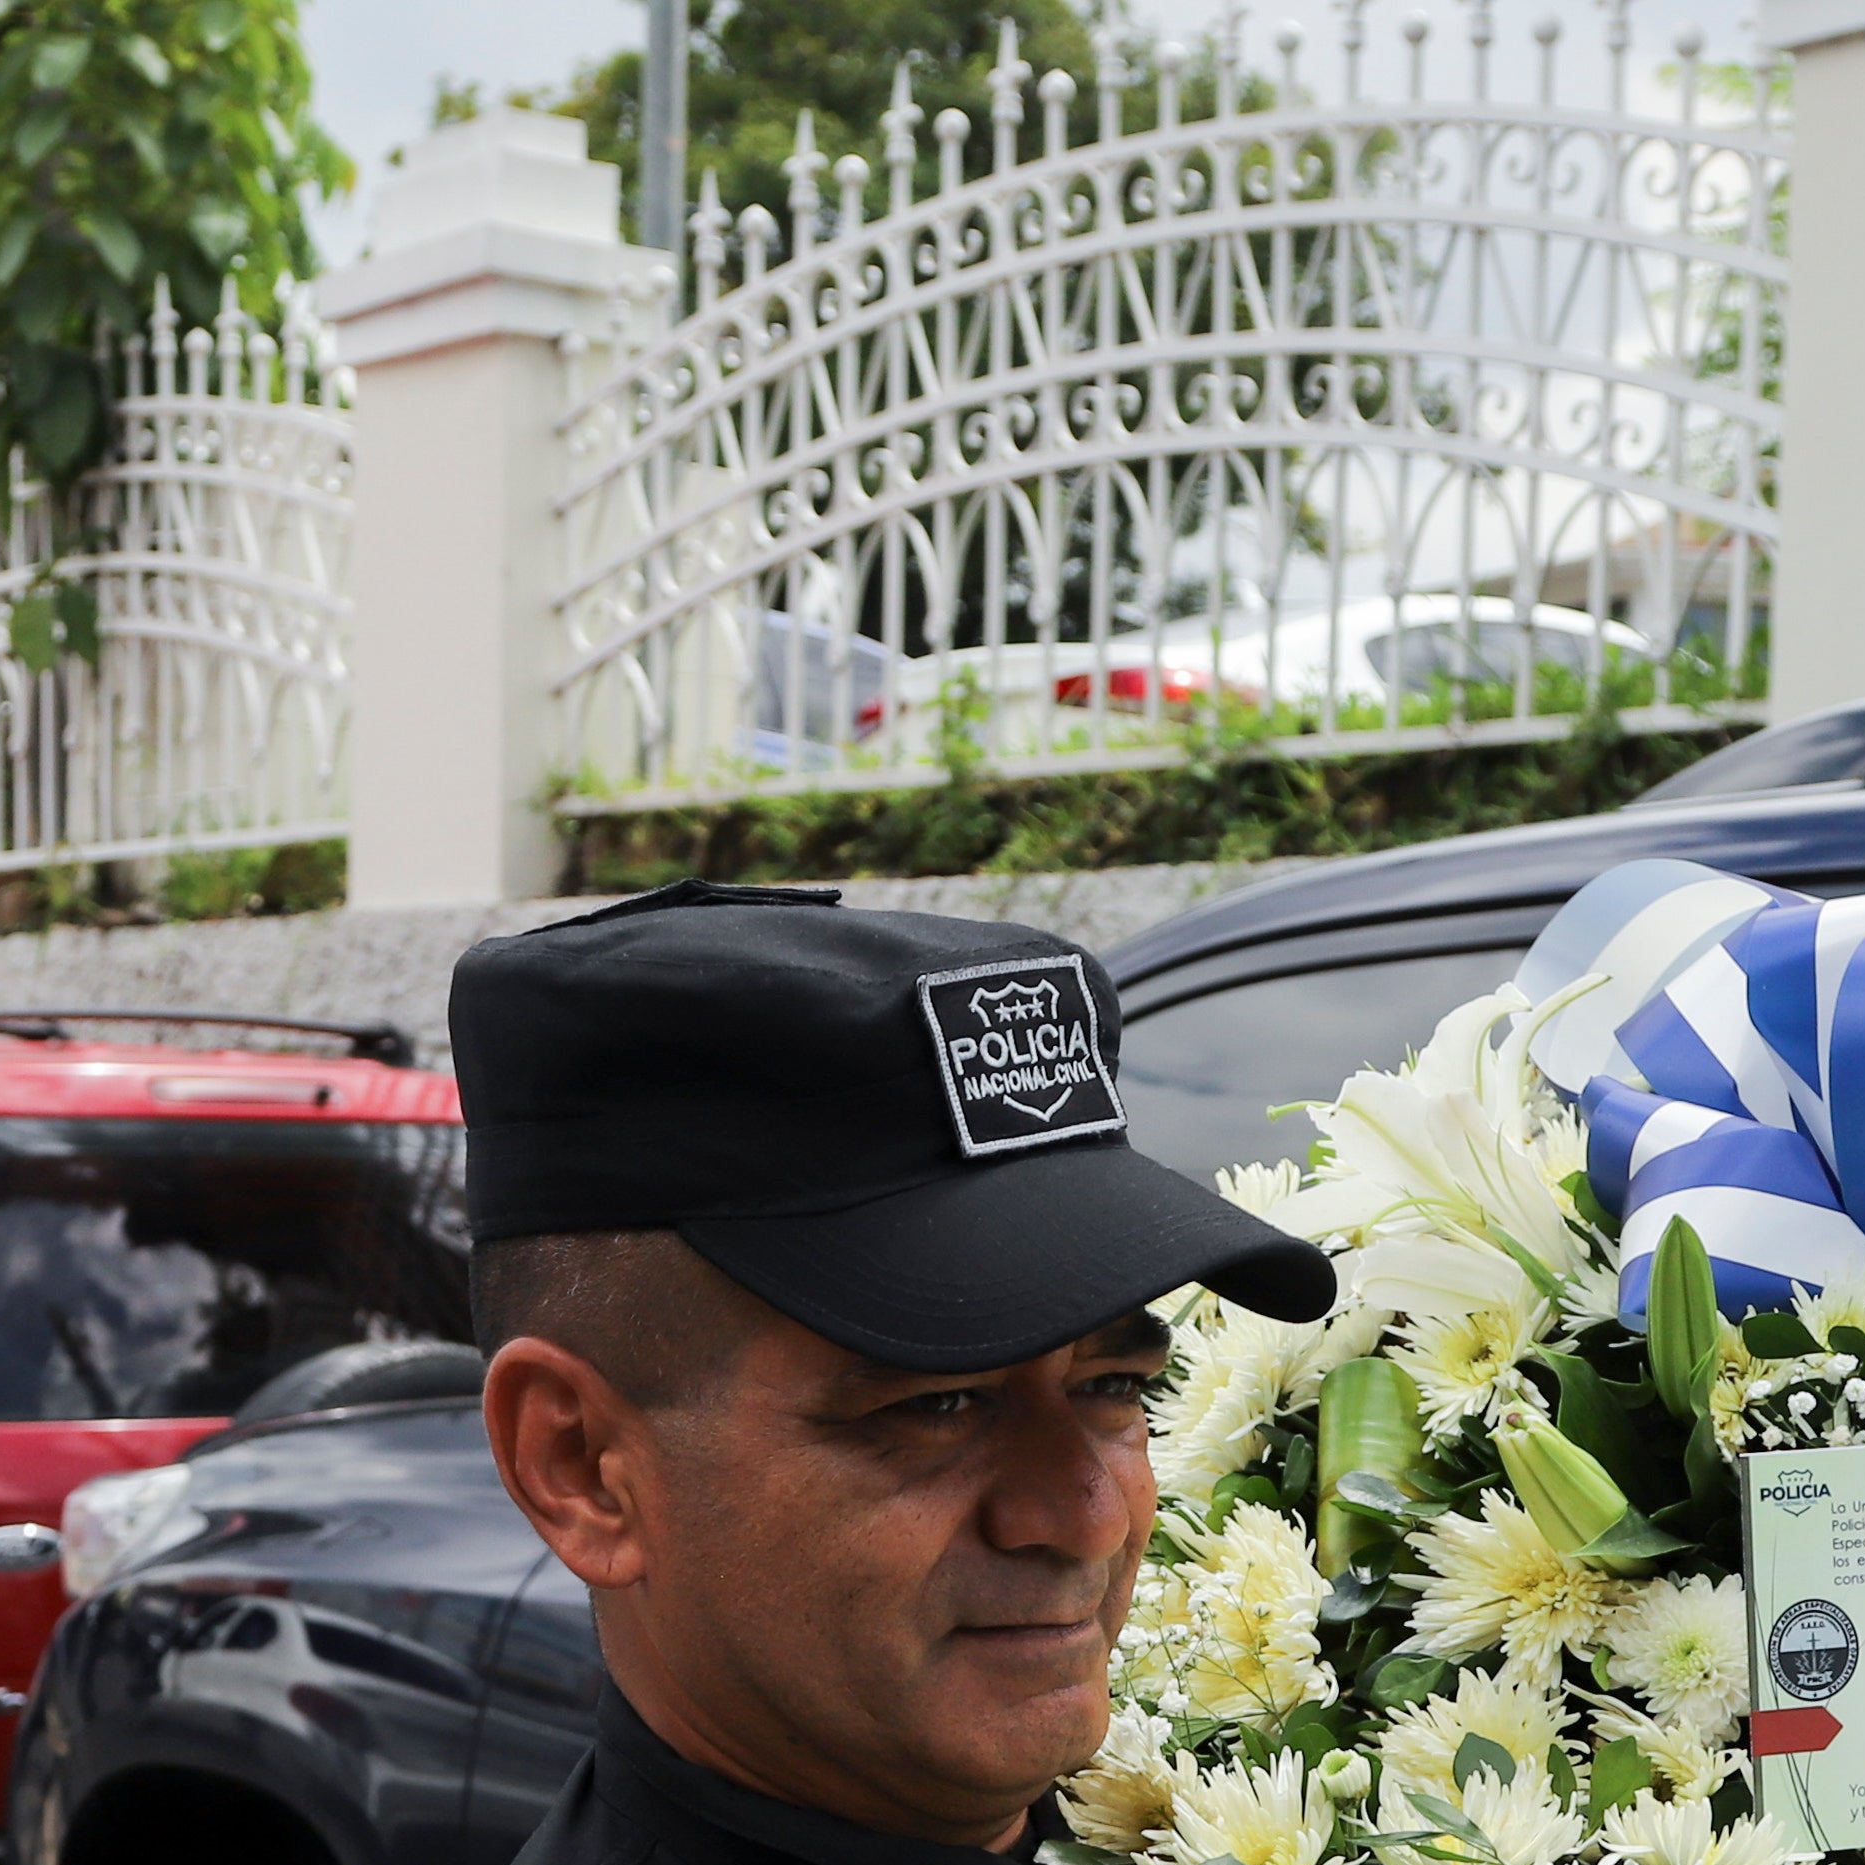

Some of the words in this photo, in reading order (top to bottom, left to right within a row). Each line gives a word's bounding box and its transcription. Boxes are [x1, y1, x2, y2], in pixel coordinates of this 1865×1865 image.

[949, 1020, 1090, 1076] POLICIA
[963, 1065, 1057, 1101] NACIONAL
[1054, 1057, 1097, 1085] CIVIL
[1760, 1483, 1832, 1502] POLICIA
[1831, 1502, 1846, 1514] La
[1833, 1556, 1851, 1569] los
[1849, 1808, 1859, 1823] y
